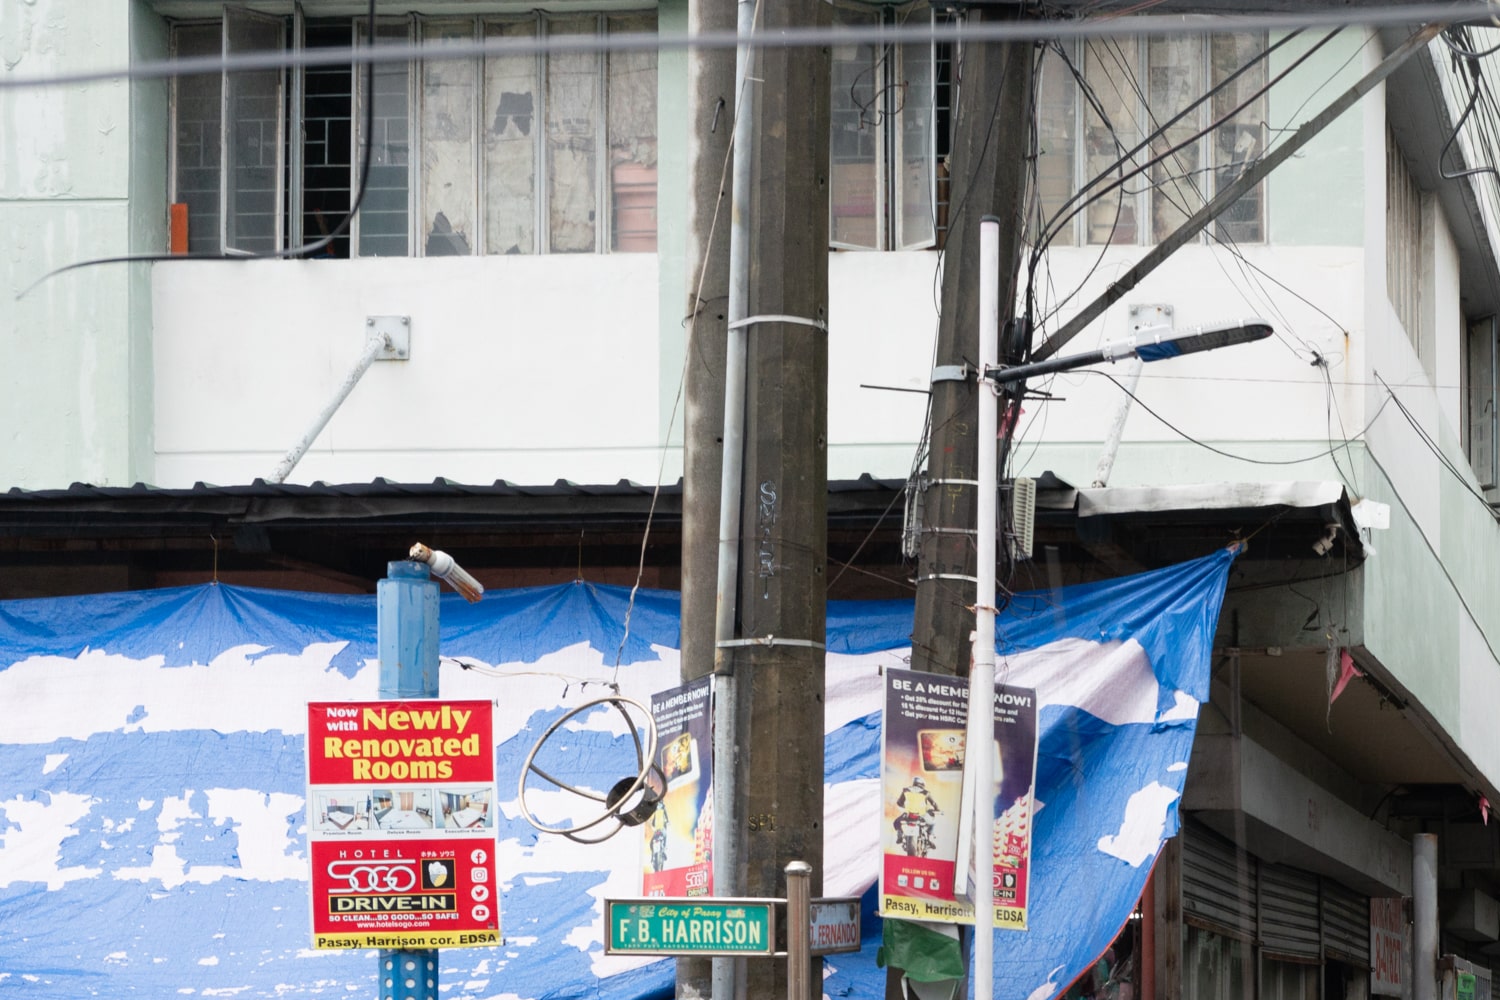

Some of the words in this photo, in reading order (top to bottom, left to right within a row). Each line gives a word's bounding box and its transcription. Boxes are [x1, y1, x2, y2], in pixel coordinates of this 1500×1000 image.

[653, 703, 661, 714] BE
[661, 701, 665, 712] A
[665, 692, 692, 710] MEMBER
[692, 685, 709, 700] NOW!
[893, 679, 912, 691] BE
[914, 682, 925, 694] A
[928, 683, 969, 699] MEMB
[994, 694, 1031, 708] NOW!
[326, 707, 358, 718] Now
[362, 706, 472, 733] Newly
[326, 720, 358, 731] with
[324, 733, 480, 759] Renovated
[352, 759, 453, 780] Rooms
[339, 849, 403, 859] HOTEL
[327, 859, 417, 893] SOGO
[337, 896, 447, 912] DRIVE-IN
[658, 907, 679, 918] City
[681, 907, 690, 918] of
[693, 907, 722, 918] Pasay
[885, 898, 919, 914] Pasay,
[996, 910, 1024, 923] EDSA
[328, 914, 340, 922] SO
[435, 912, 459, 920] SAFE!
[356, 919, 430, 929] www.hotelsogo.com
[318, 937, 362, 948] Pasay,
[366, 934, 426, 947] Harrison
[429, 935, 455, 946] cor.
[459, 934, 497, 944] EDSA
[662, 919, 761, 944] HARRISON
[818, 923, 857, 944] FERNANDO
